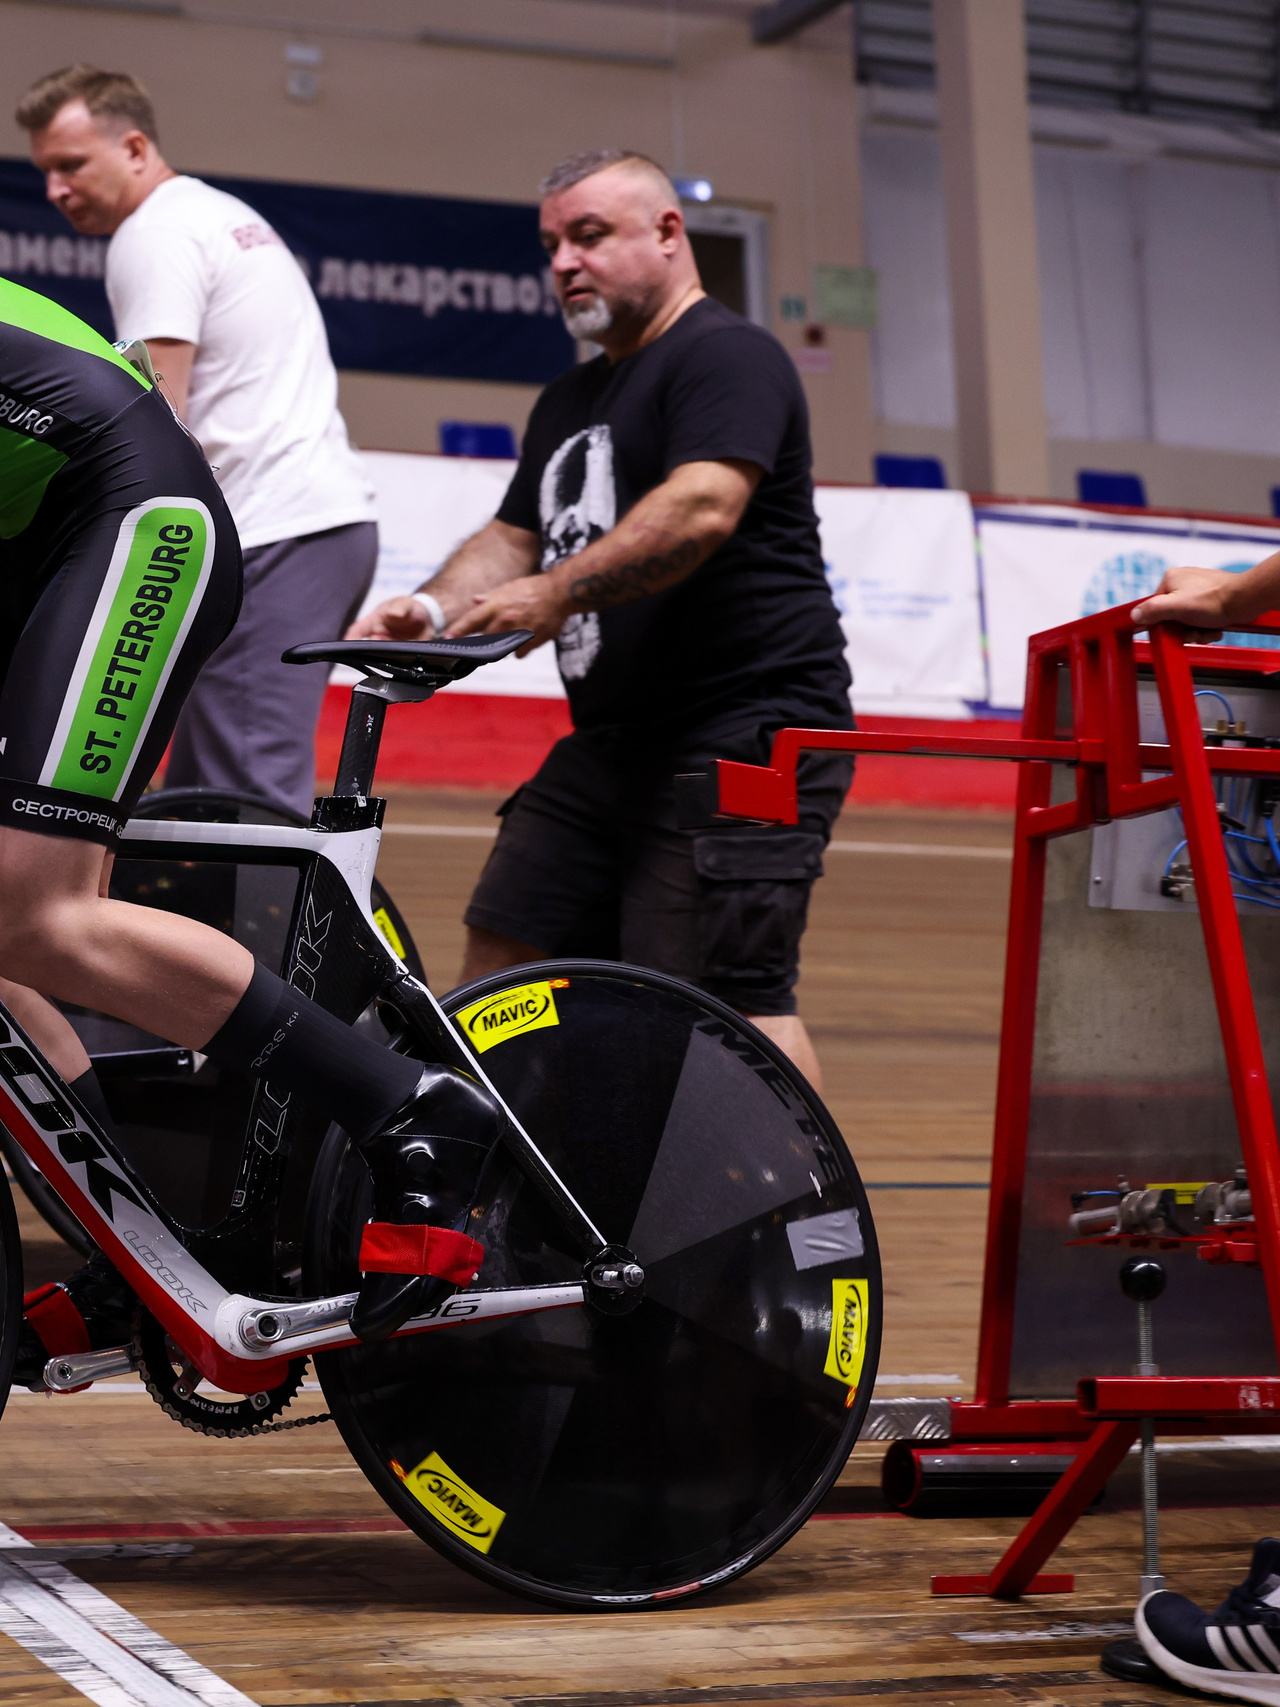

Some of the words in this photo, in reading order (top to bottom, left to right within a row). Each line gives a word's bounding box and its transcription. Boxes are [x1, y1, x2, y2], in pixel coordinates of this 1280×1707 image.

[94, 524, 194, 721] PETERSBURG
[79, 730, 122, 774] ST.
[482, 999, 538, 1031] MAVIC
[123, 1229, 209, 1314] LOOK
[839, 1297, 857, 1364] MAVIC
[428, 1478, 484, 1529] MAVIC
